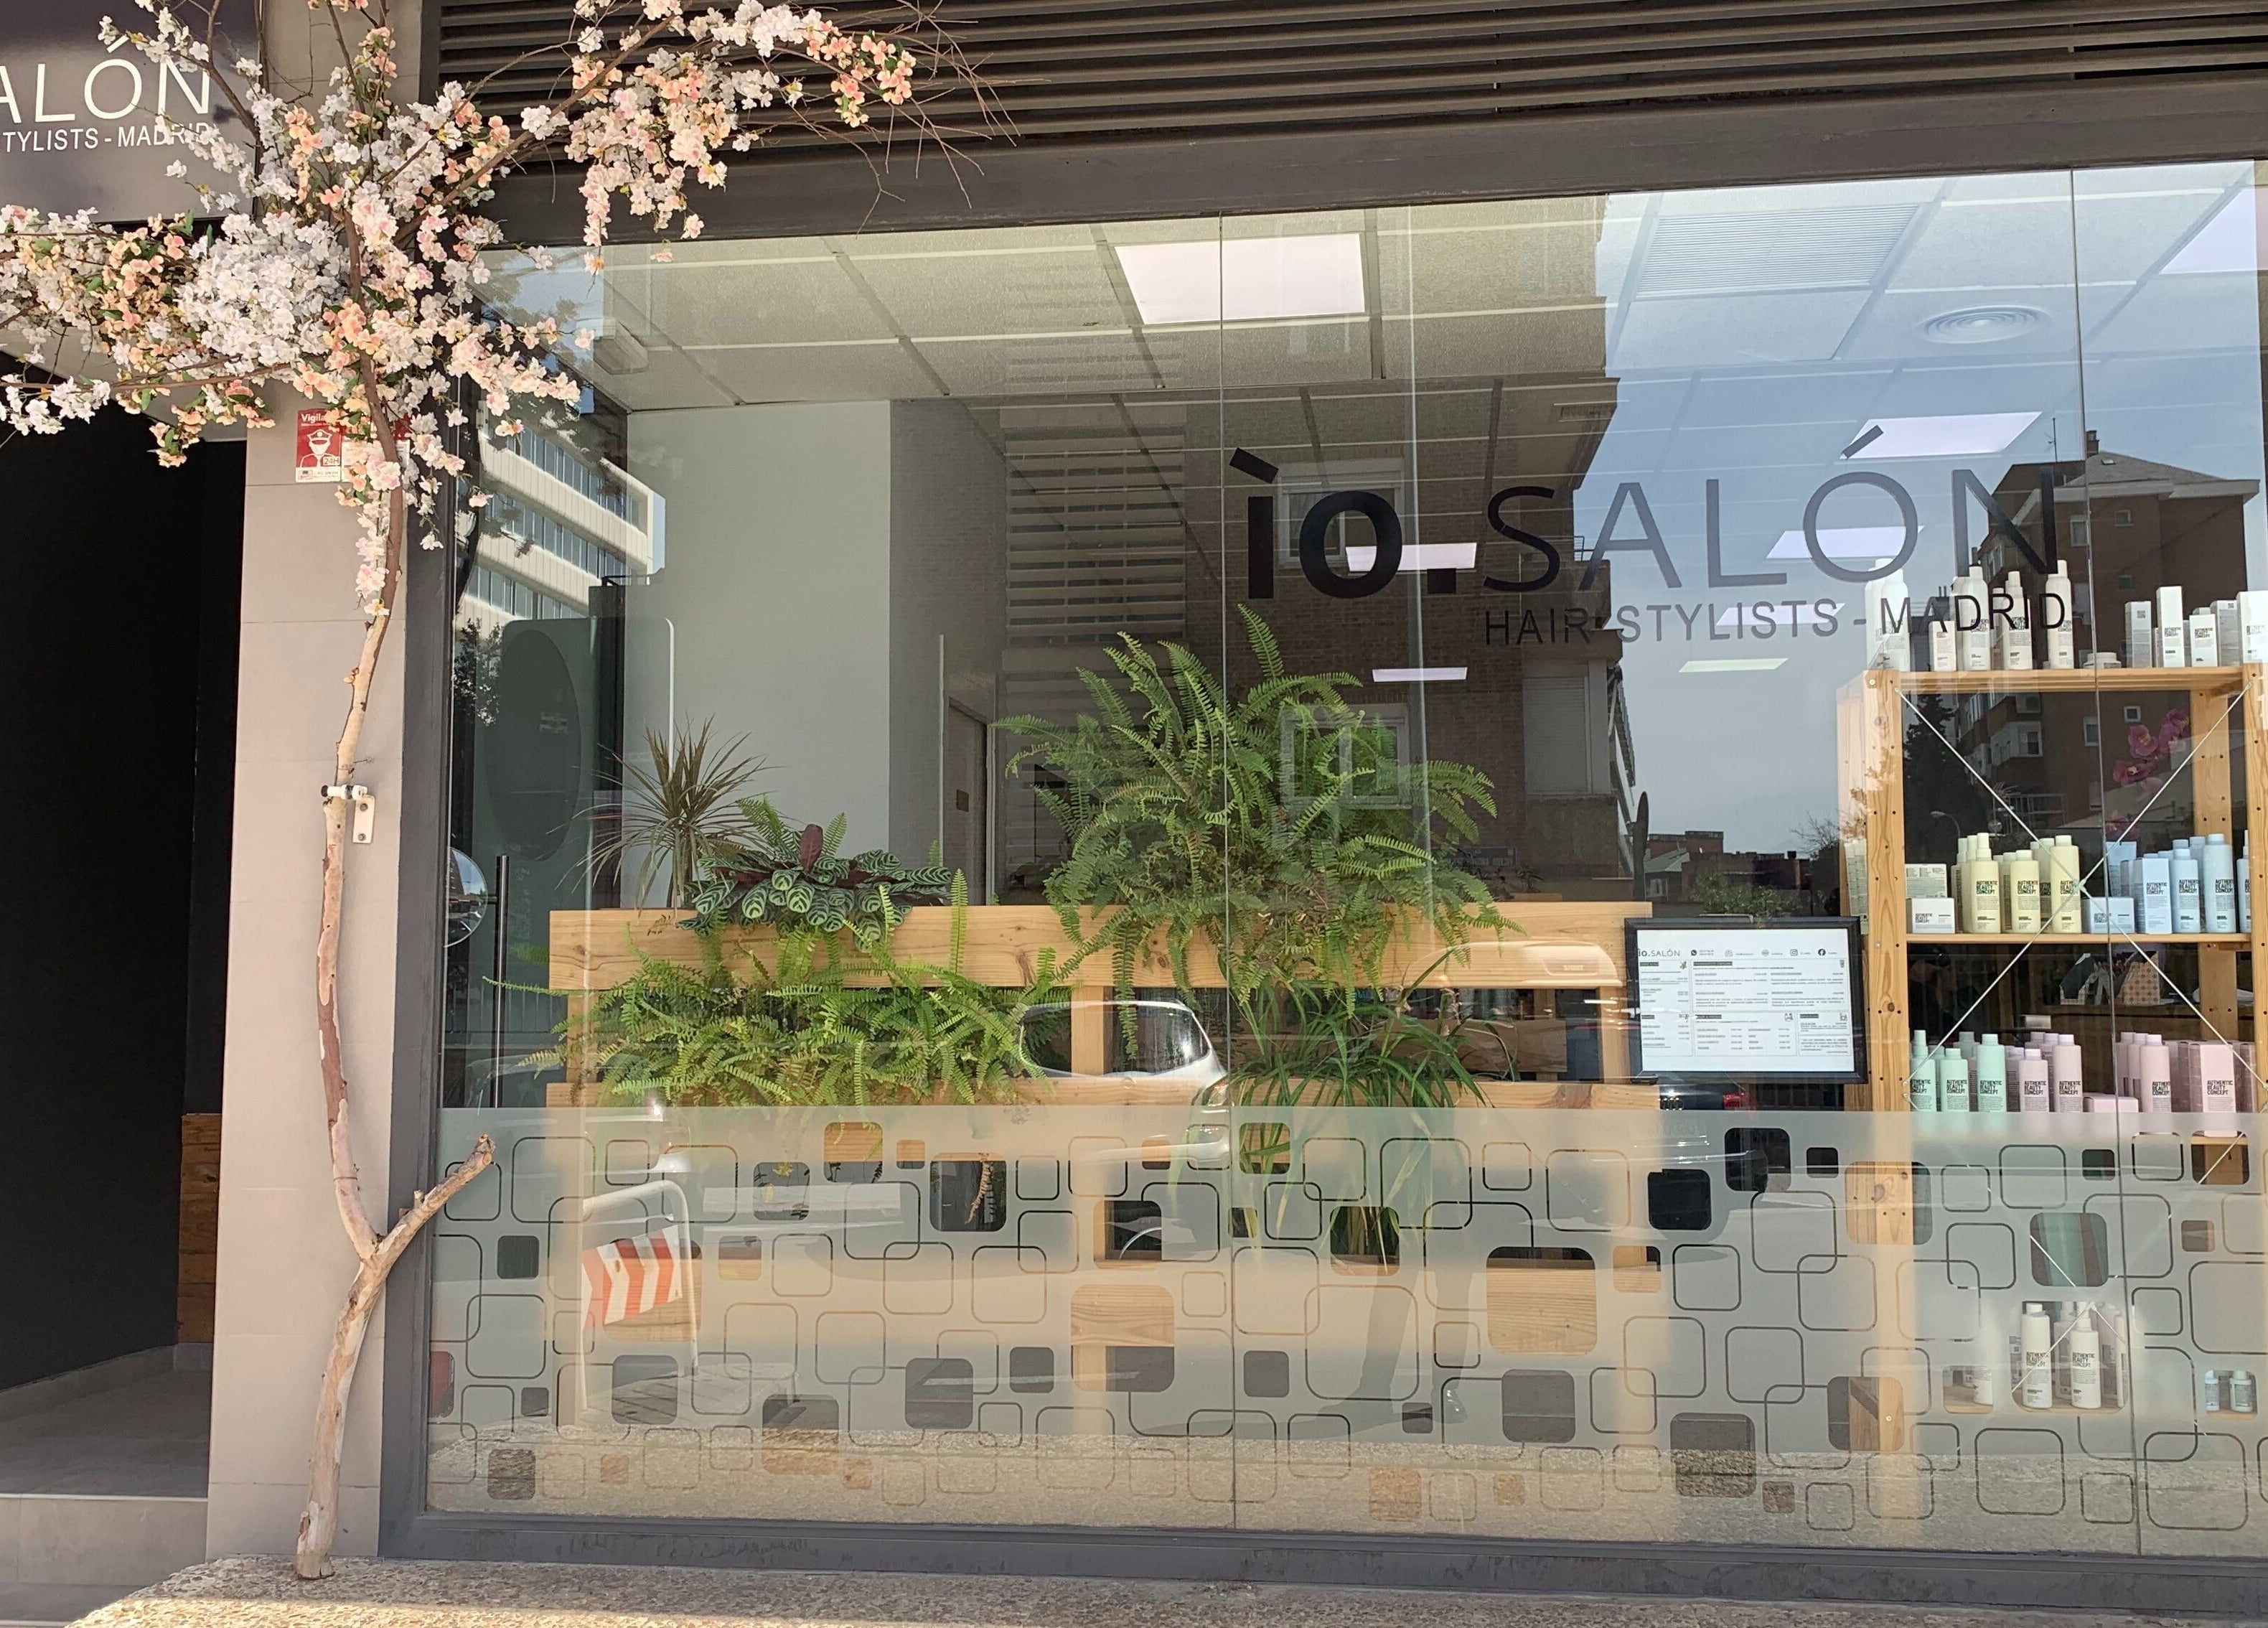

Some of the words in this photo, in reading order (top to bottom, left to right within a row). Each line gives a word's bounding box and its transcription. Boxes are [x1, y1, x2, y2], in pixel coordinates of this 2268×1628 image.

[3, 128, 98, 152] TYLISTS
[1485, 608, 1590, 645] HAIR
[1616, 598, 1838, 643] STYLISTS
[1880, 593, 2065, 635] MADRID
